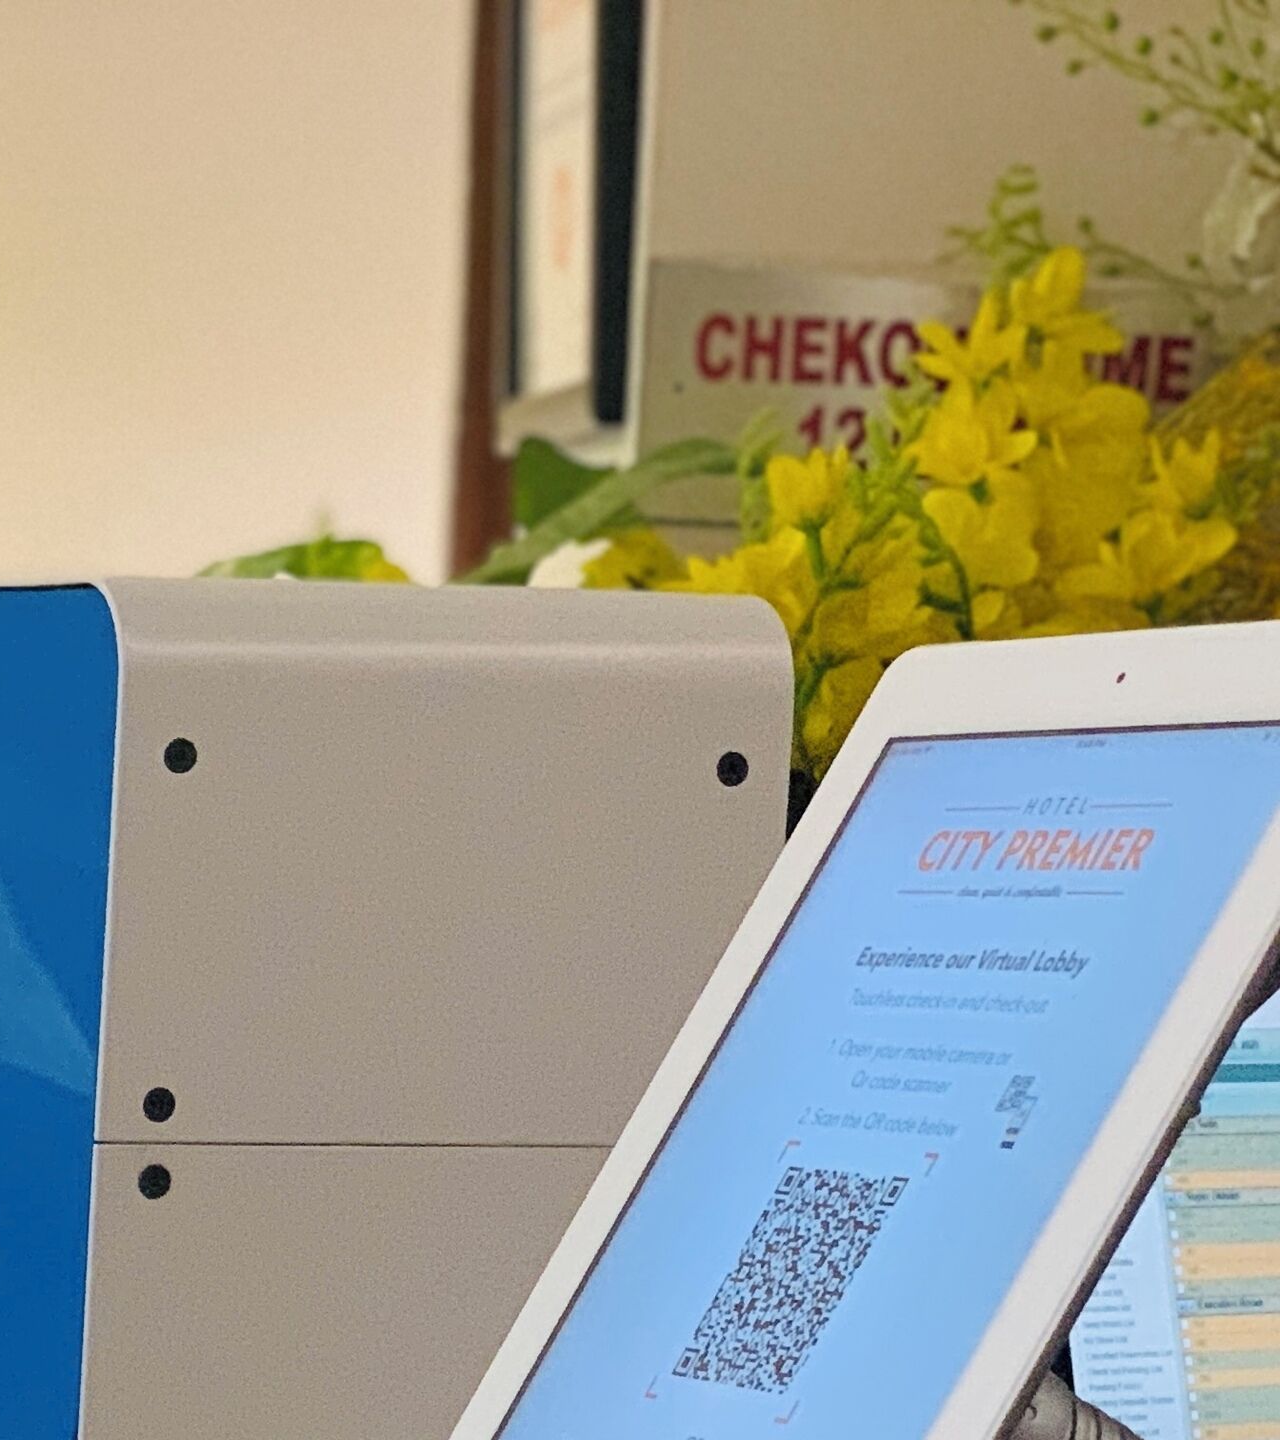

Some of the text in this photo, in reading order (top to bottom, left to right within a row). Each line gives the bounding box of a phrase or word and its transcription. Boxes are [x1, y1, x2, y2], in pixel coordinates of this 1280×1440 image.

[696, 311, 966, 392] CHEKO
[1023, 797, 1088, 815] HOTEL
[918, 828, 1155, 872] CITY PREMIER
[856, 946, 1090, 979] Experience our Virtual Lobby
[851, 987, 906, 1008] Touchless
[958, 993, 987, 1012] and
[839, 1038, 873, 1060] Open
[902, 1045, 948, 1063] mobile
[948, 1049, 993, 1066] camera
[901, 1078, 953, 1093] scanner
